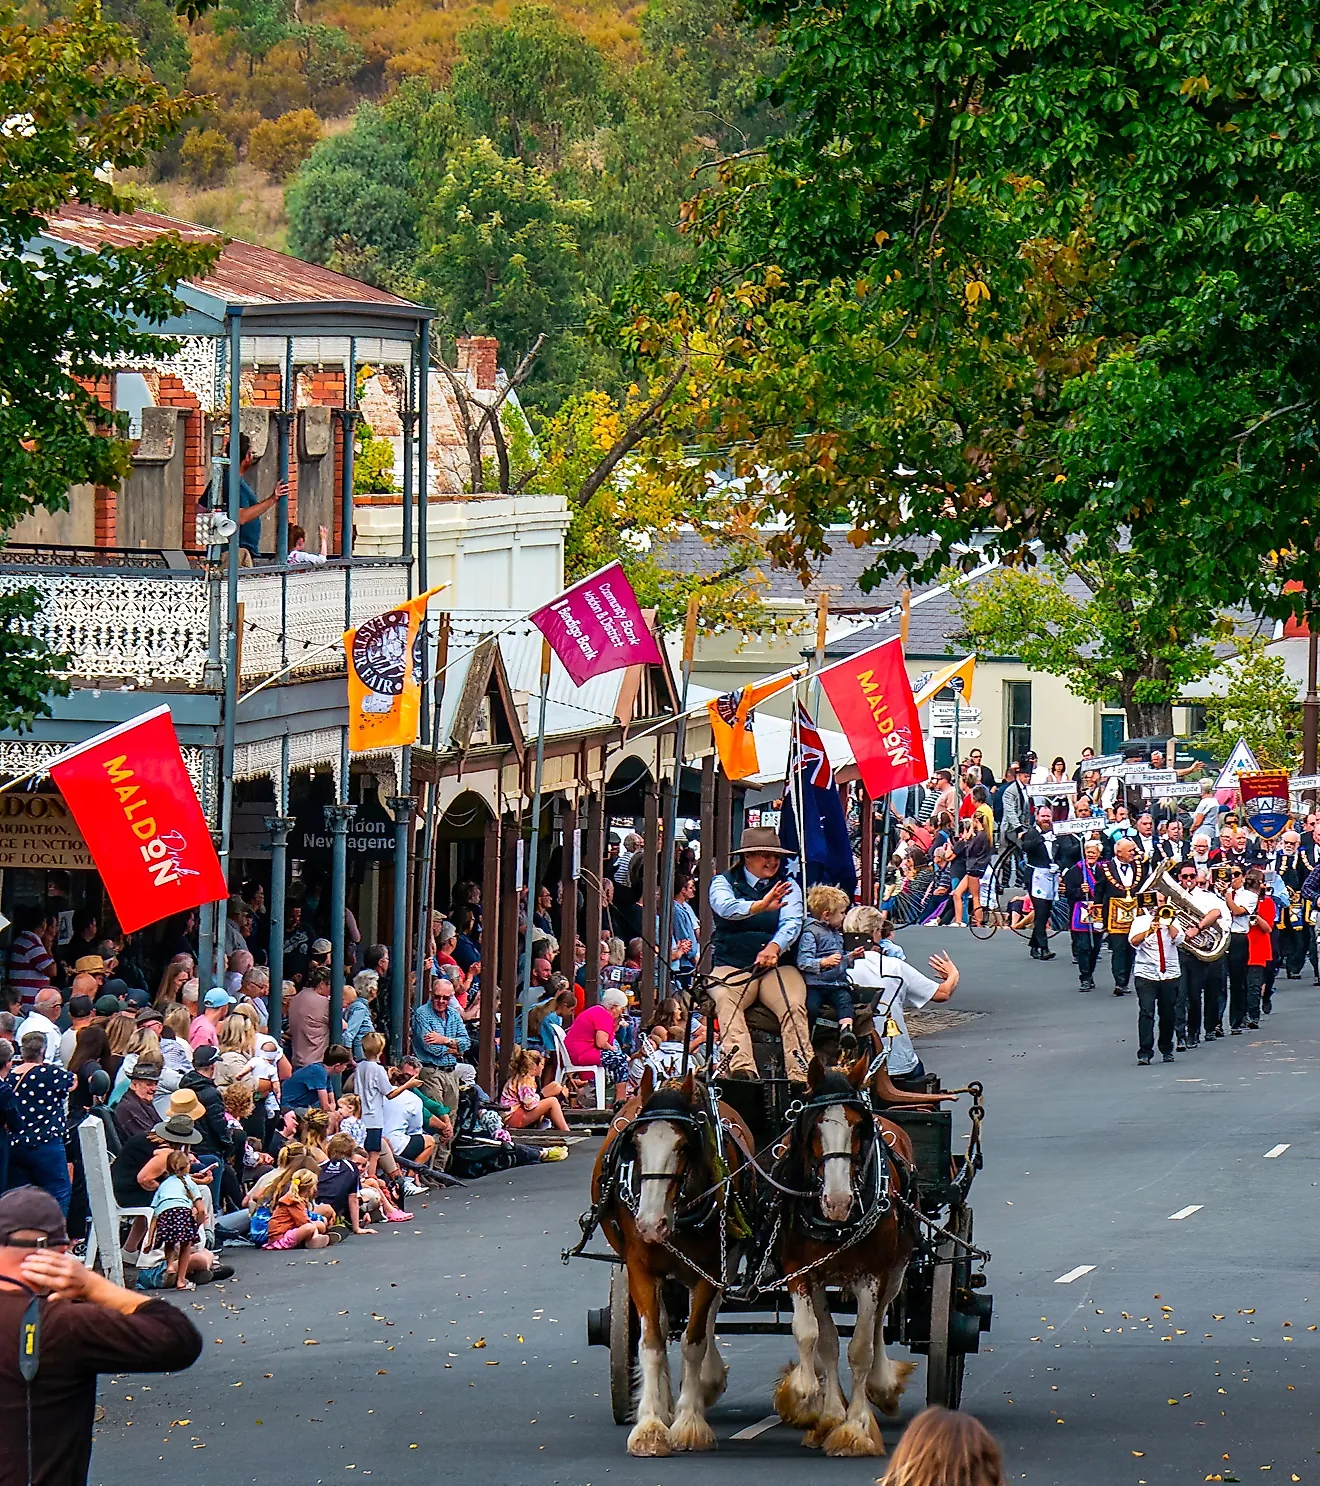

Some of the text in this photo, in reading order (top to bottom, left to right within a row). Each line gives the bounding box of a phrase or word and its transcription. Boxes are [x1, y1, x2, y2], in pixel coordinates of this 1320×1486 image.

[557, 606, 599, 661] Bendigo Bank
[599, 582, 641, 646] Community Bank
[600, 615, 625, 648] District
[354, 615, 394, 694] EASTER FAIR
[856, 669, 909, 767] MALDON
[0, 796, 67, 819] DON
[102, 754, 179, 887] MALDON
[22, 853, 68, 865] LOCAL
